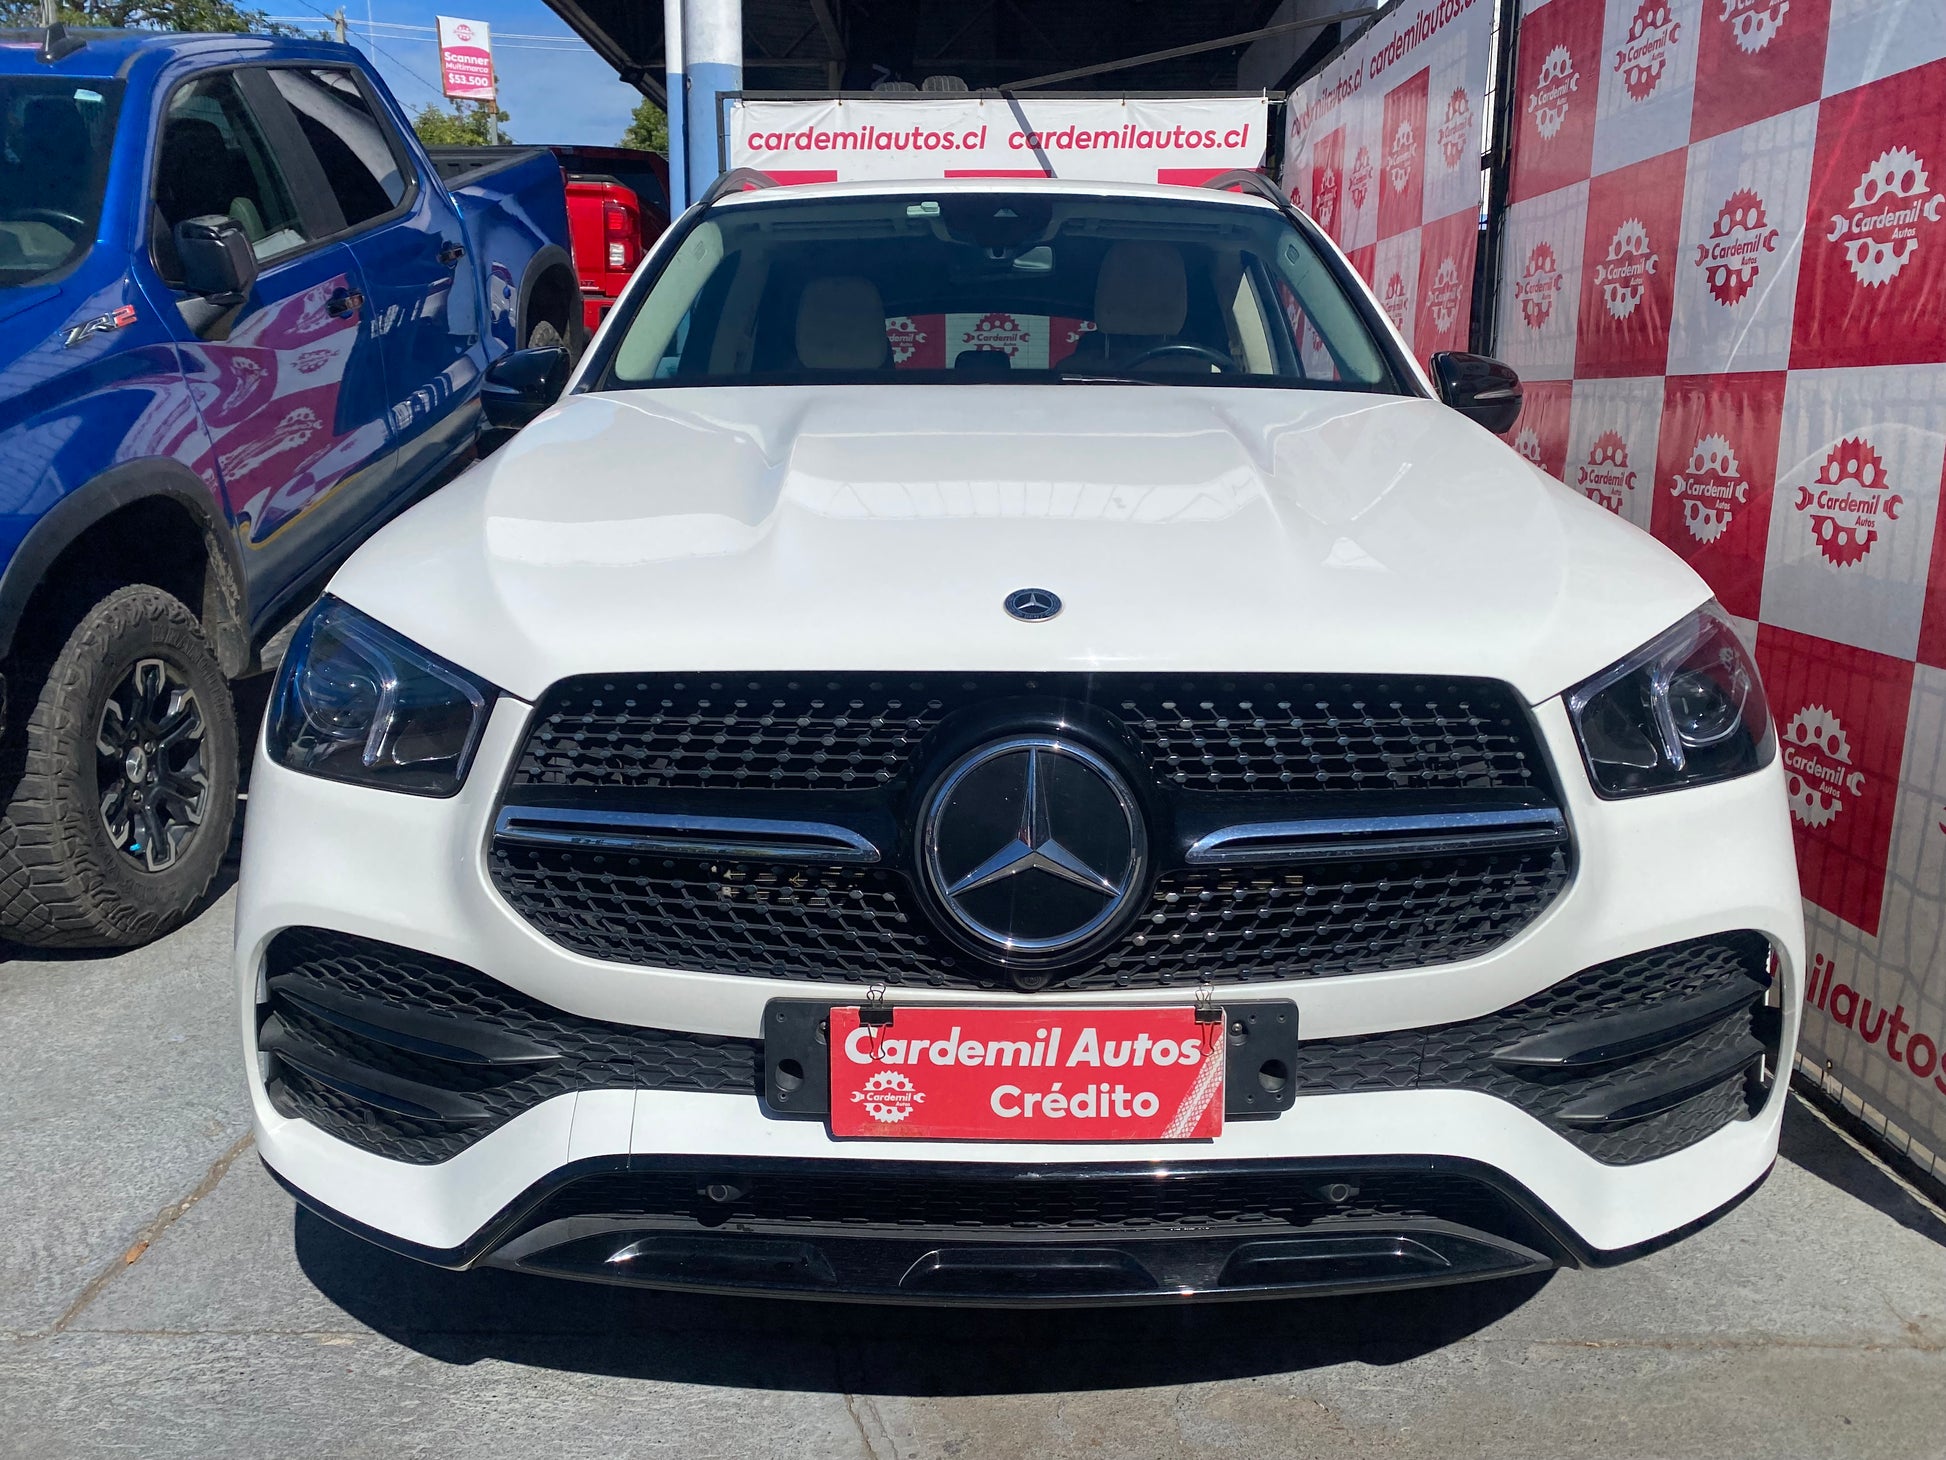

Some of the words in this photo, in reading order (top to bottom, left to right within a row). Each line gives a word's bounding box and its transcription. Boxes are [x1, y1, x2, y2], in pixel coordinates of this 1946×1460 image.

[1369, 0, 1475, 79] cardemilautos.
[1627, 28, 1668, 63] Cardemil
[444, 51, 490, 66] Scanner
[445, 62, 489, 73] Multimarca
[448, 73, 489, 86] $53.500
[1538, 78, 1570, 103] Cardemil
[747, 124, 987, 153] cardemilautos.cl
[1008, 123, 1249, 151] cardemilautos.cl
[1852, 199, 1922, 234] Cardemil
[1891, 227, 1917, 241] Autos
[1711, 233, 1762, 260] Cardemil
[1607, 257, 1646, 279] Cardemil
[1741, 255, 1757, 266] Autos
[977, 333, 1018, 342] Cardemil
[1588, 469, 1626, 487] Cardemil
[1686, 478, 1734, 499] Cardemil
[1715, 499, 1730, 510] Autos
[1817, 490, 1882, 515] Cardemil
[1855, 515, 1876, 528] Autos
[1784, 747, 1846, 786] Cardemil
[1819, 781, 1840, 798] Autos
[844, 1026, 1057, 1067] Cardemil
[1066, 1026, 1201, 1067] Autos
[866, 1092, 912, 1102] Cardemil
[989, 1084, 1160, 1119] Crédito
